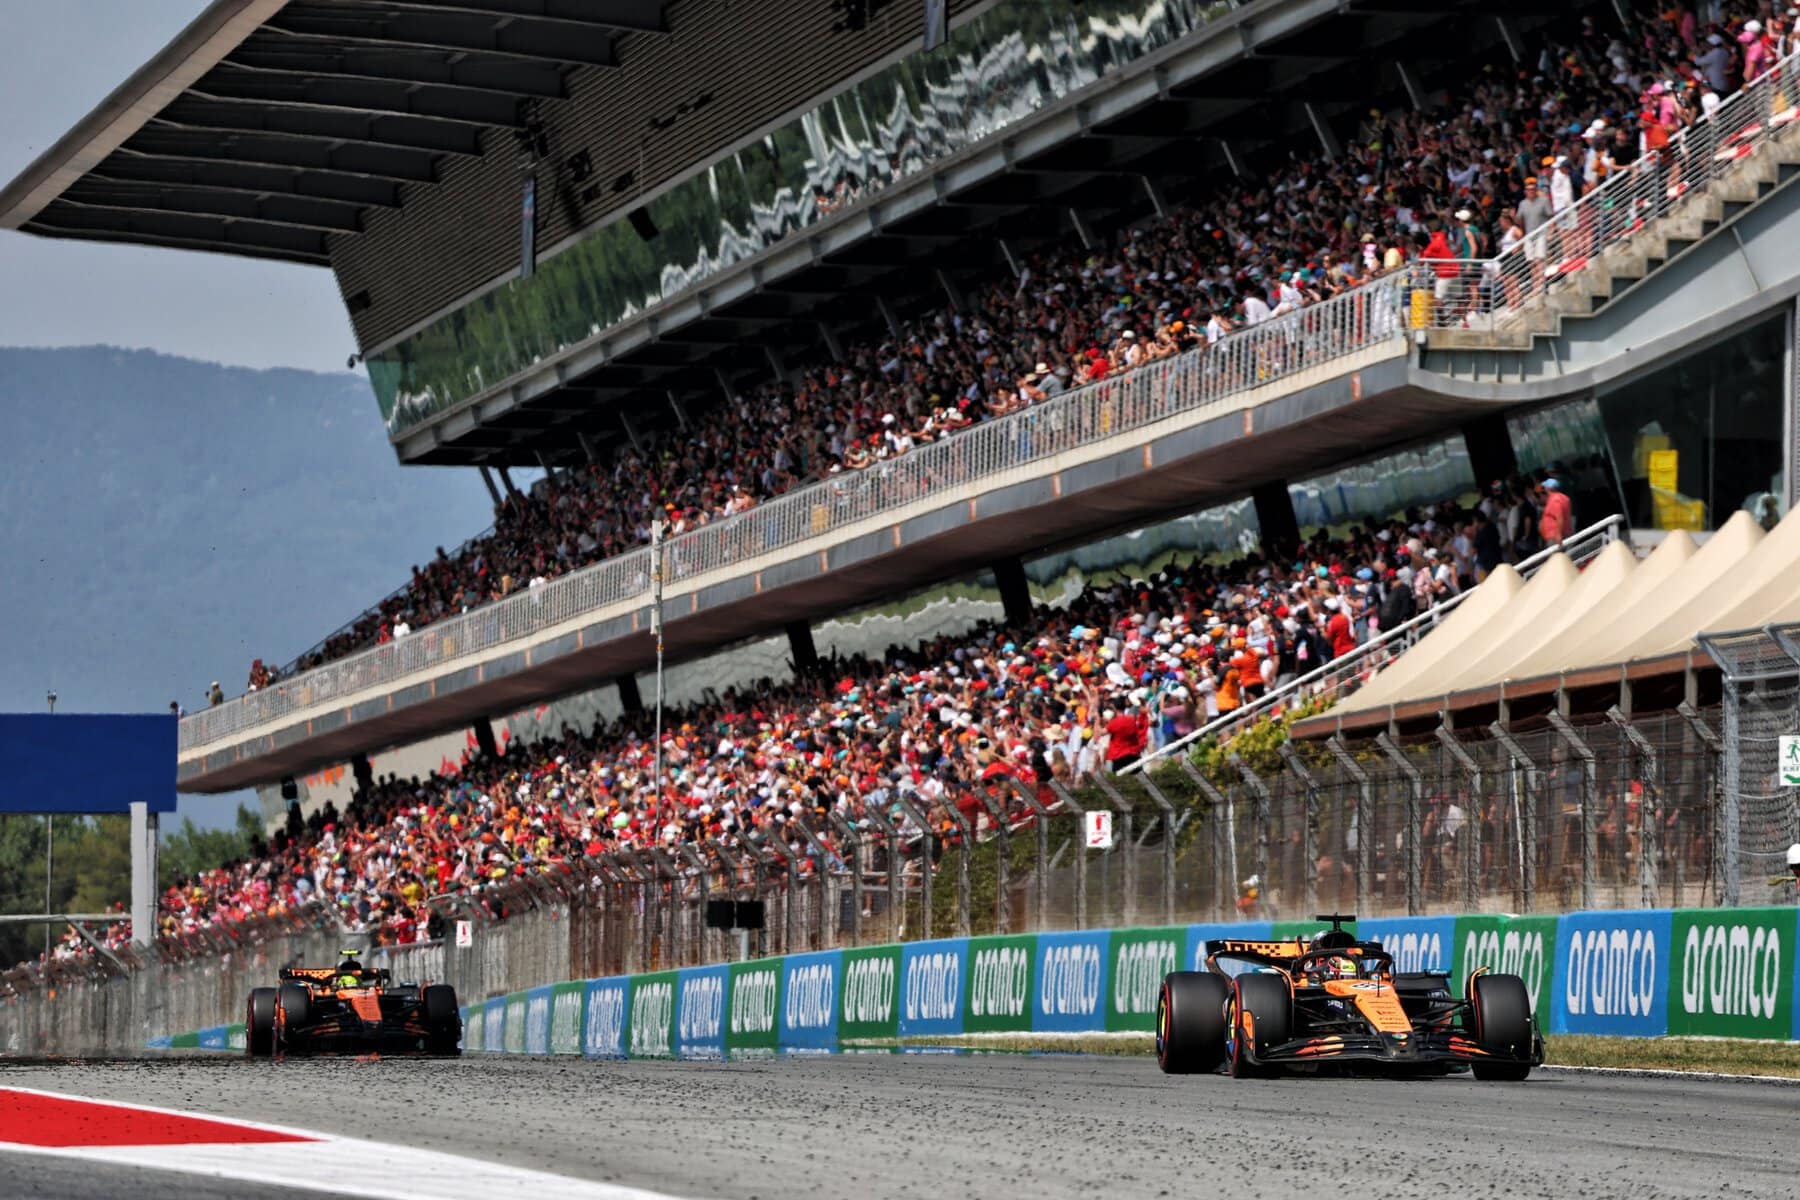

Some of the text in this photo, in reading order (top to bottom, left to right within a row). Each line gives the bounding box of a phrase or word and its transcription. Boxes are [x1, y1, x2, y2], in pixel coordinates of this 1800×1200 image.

[786, 964, 832, 1029] aramco
[844, 957, 894, 1022] aramco
[907, 952, 958, 1019] aramco
[972, 947, 1027, 1016] aramco
[1042, 944, 1100, 1015] aramco
[1567, 929, 1655, 1016] aramco
[1683, 925, 1779, 1019] aramco
